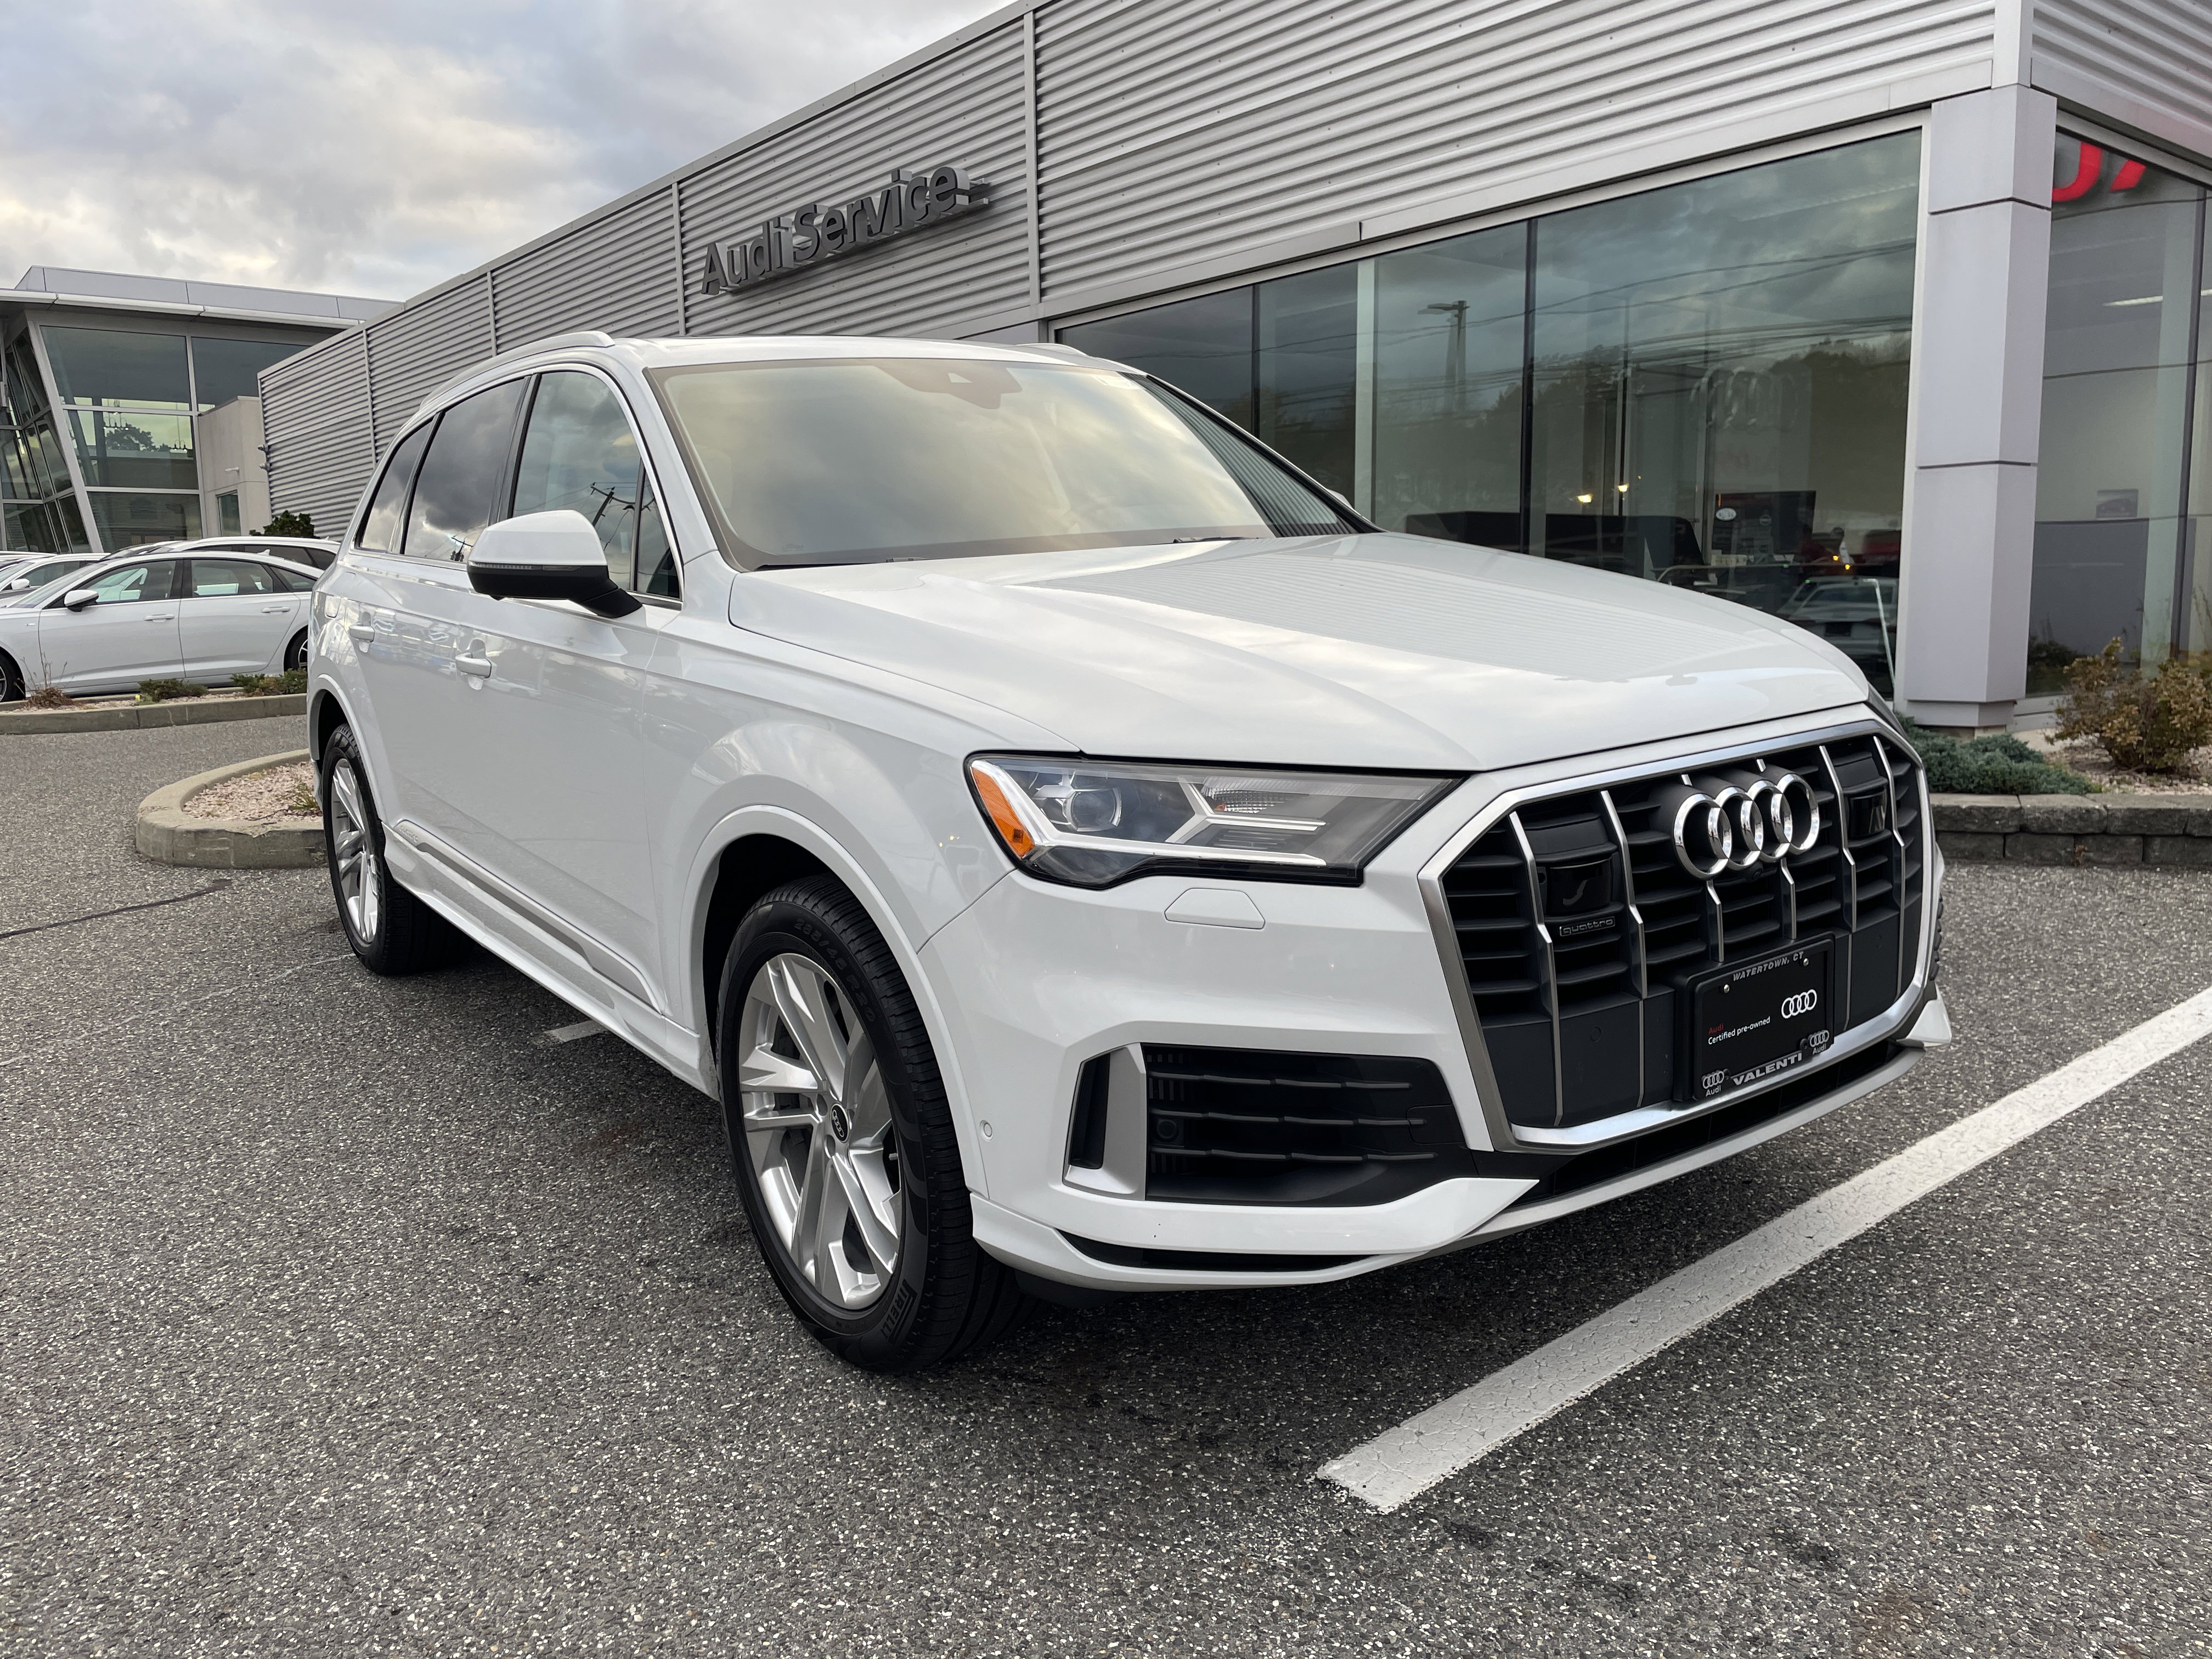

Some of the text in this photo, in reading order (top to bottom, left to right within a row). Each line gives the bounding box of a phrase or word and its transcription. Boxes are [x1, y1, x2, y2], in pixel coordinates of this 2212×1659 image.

[702, 166, 969, 295] Audi Service
[1563, 919, 1614, 934] quattro
[1733, 951, 1804, 981] WATERTOWN, CT
[1708, 1023, 1724, 1035] Audi
[1708, 1016, 1770, 1045] Certified pre-owned
[1813, 1044, 1826, 1055] Audi
[1732, 1052, 1802, 1086] VALENTI
[1706, 1085, 1722, 1097] Audi
[881, 1279, 918, 1344] PIRELLI
